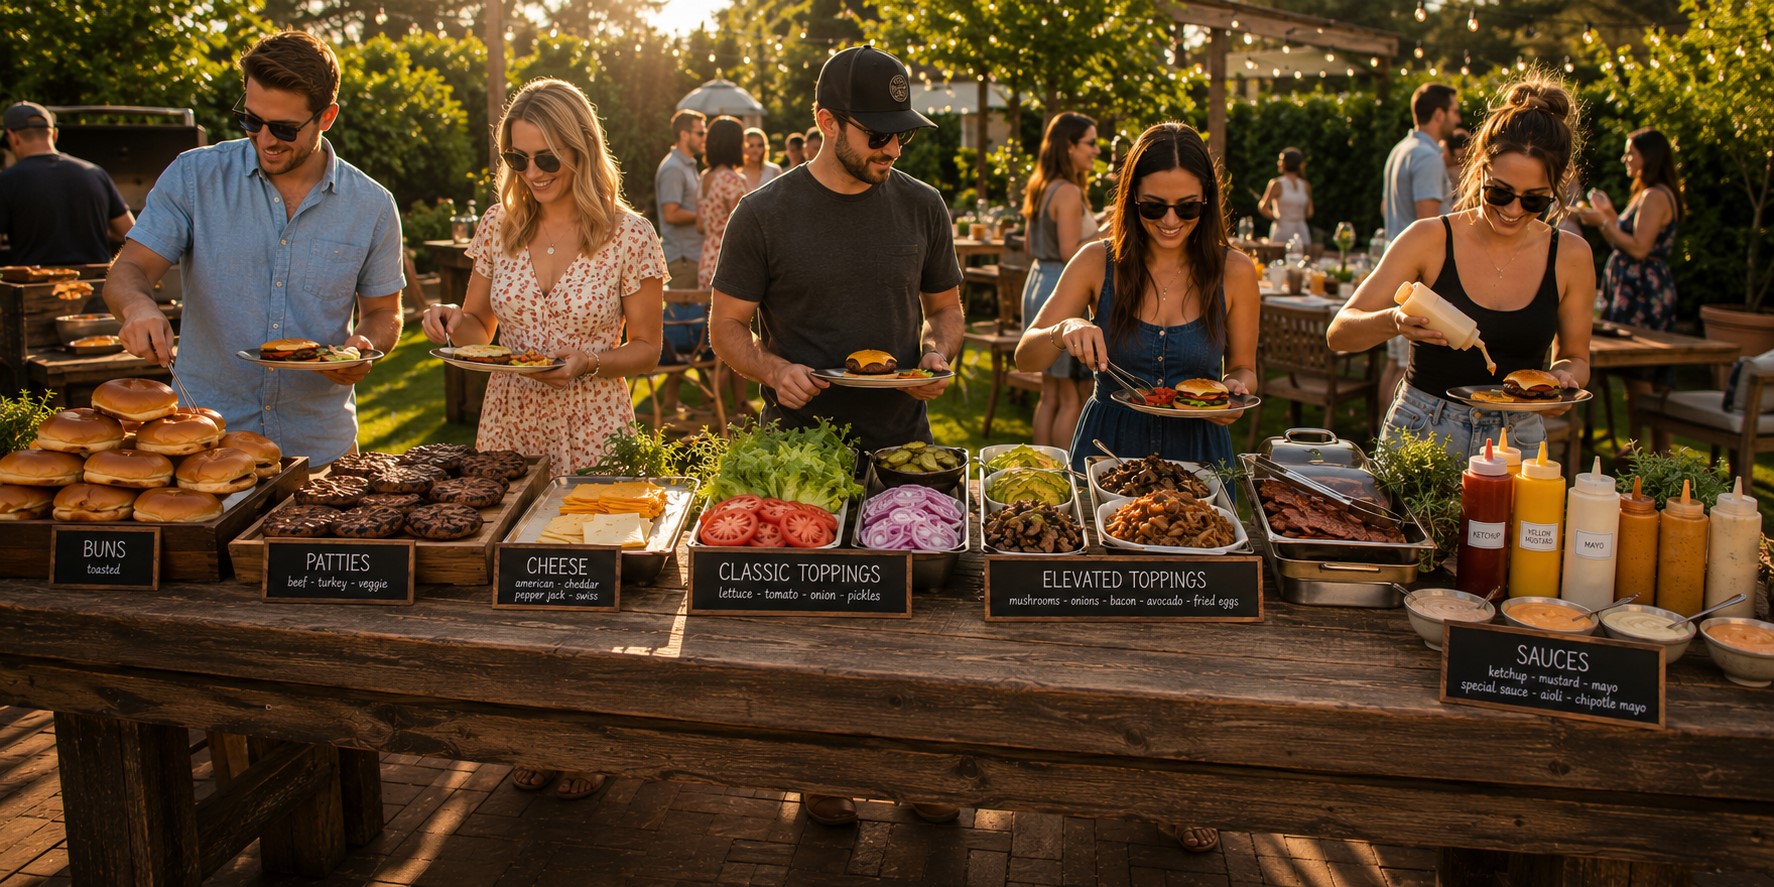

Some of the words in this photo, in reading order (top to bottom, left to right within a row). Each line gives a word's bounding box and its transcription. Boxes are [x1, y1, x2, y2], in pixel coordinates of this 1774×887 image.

[1472, 530, 1501, 541] KETCHUP
[83, 539, 126, 559] BUNS
[1584, 540, 1605, 550] MAYO
[87, 563, 121, 575] toasted
[306, 552, 370, 572] PATTIES
[526, 556, 589, 576] CHEESE
[718, 561, 790, 583] CLASSIC
[797, 563, 881, 584] TOPPINGS
[1043, 570, 1123, 589] ELEVATED
[1128, 570, 1207, 589] TOPPINGS
[287, 575, 308, 589] beef
[317, 576, 348, 592] turkey
[358, 578, 388, 593] veggie
[515, 578, 554, 589] american
[564, 578, 600, 589] cheddar
[514, 591, 545, 602] pepper
[546, 590, 566, 603] jack
[575, 591, 599, 601] swiss
[718, 586, 753, 599] lettuce
[764, 588, 799, 600] tomato
[810, 589, 836, 601] onion
[847, 588, 881, 604] pickles
[1009, 593, 1061, 606] mushrooms
[1070, 595, 1100, 606] onions
[1110, 594, 1137, 606] bacon
[1146, 594, 1183, 606] avocado
[1193, 594, 1216, 607] fried
[1218, 597, 1239, 610] eggs
[1516, 644, 1590, 672] SAUCES
[1488, 664, 1528, 685] ketchup
[1538, 673, 1580, 688] mustard
[1591, 682, 1618, 696] mayo
[1460, 679, 1497, 694] special
[1499, 685, 1529, 697] sauce
[1540, 689, 1563, 702] aioli
[1574, 693, 1617, 711] chipotle
[1619, 702, 1647, 716] mayo
